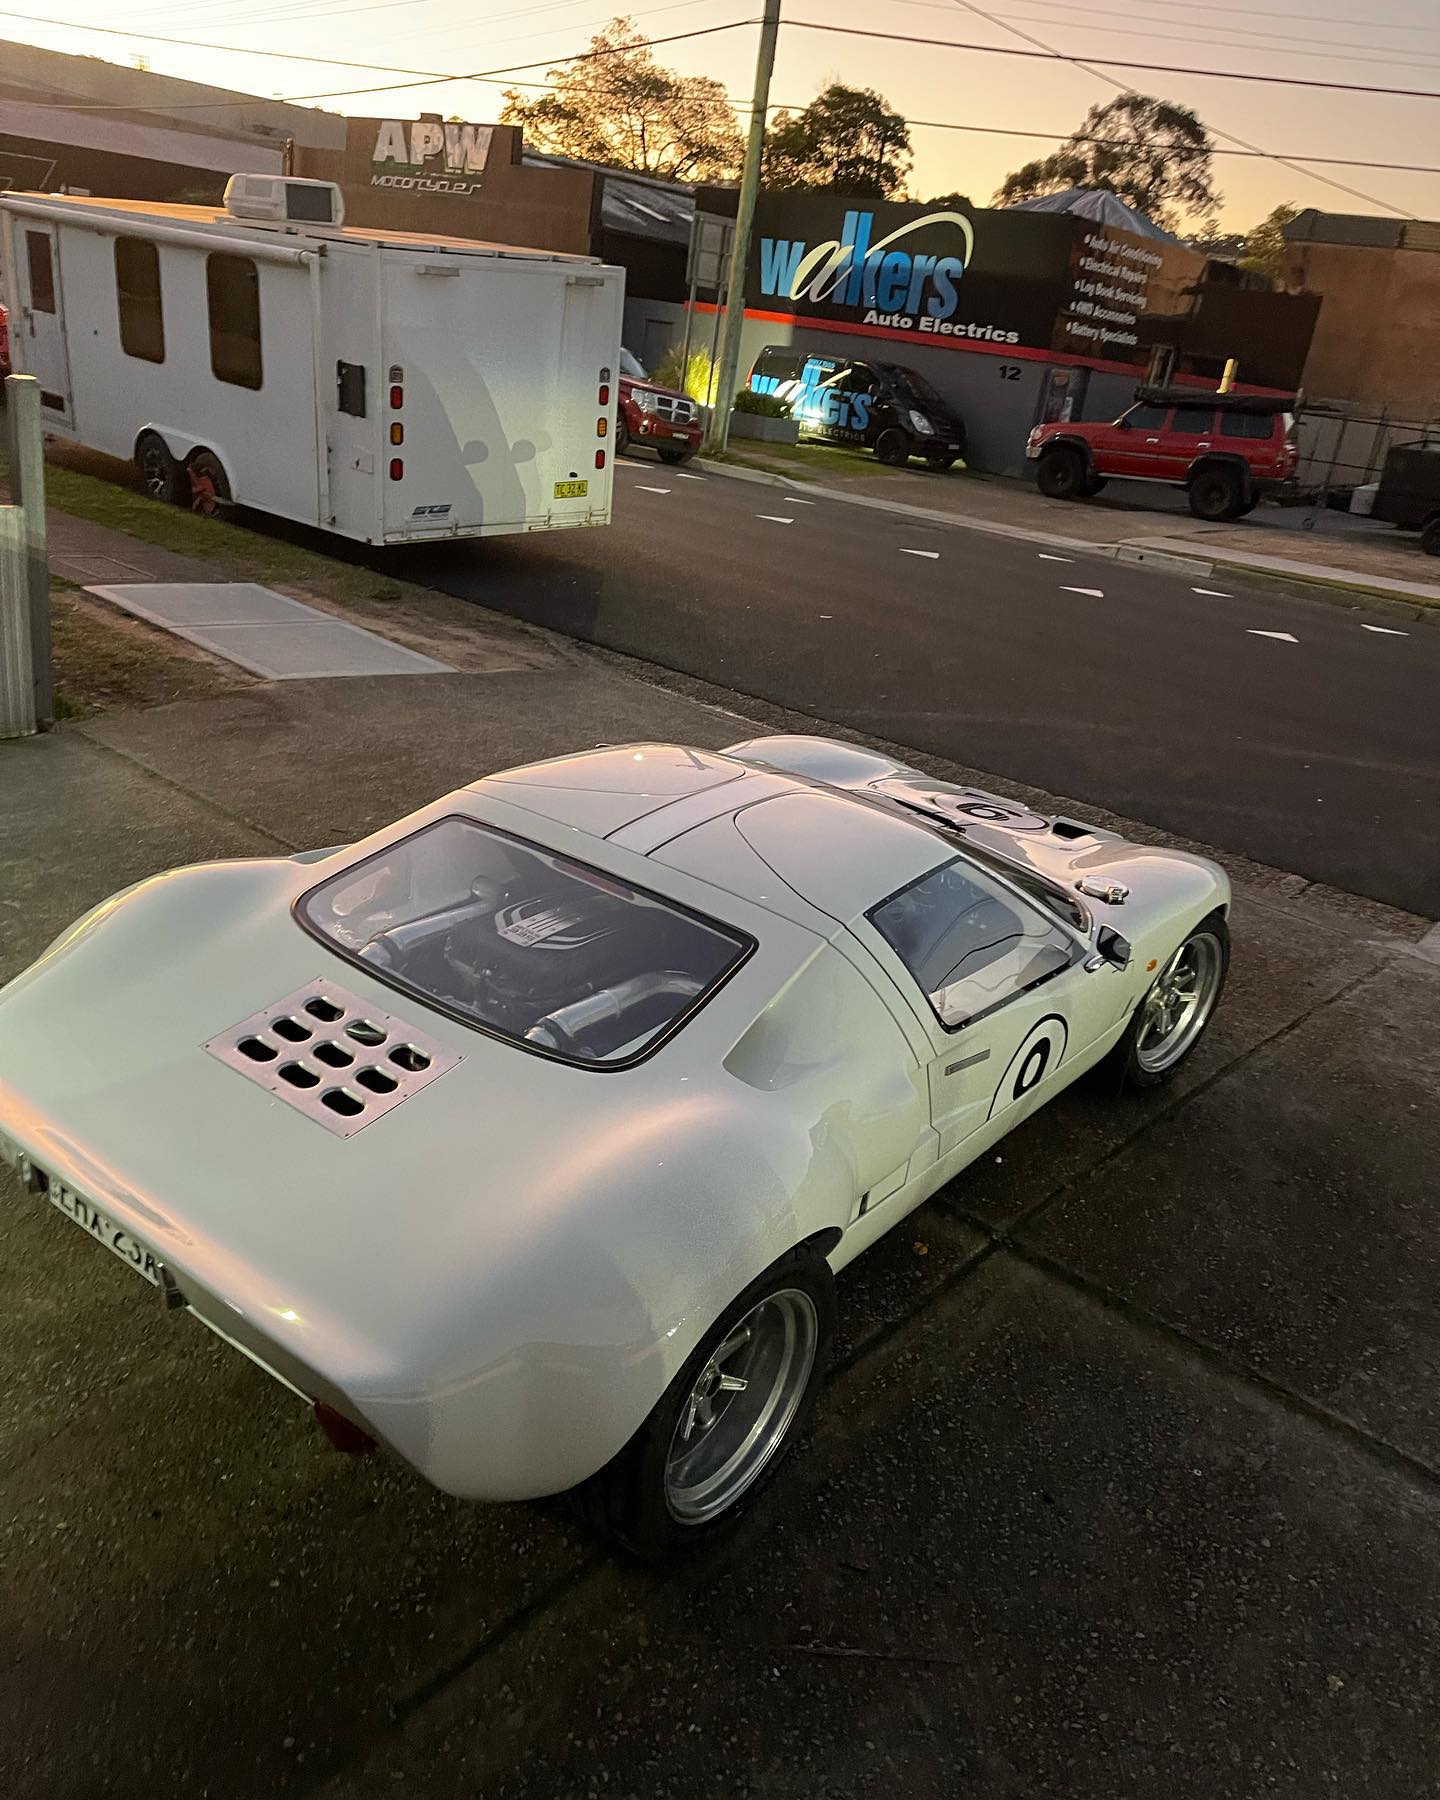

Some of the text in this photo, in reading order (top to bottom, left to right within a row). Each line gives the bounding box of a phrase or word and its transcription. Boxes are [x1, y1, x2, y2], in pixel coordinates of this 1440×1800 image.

[372, 120, 494, 171] APW
[760, 210, 965, 320] walkers
[1080, 279, 1096, 297] Log
[1096, 283, 1114, 297] Book
[863, 310, 1020, 344] Auto Electrics
[1000, 365, 1021, 380] 12
